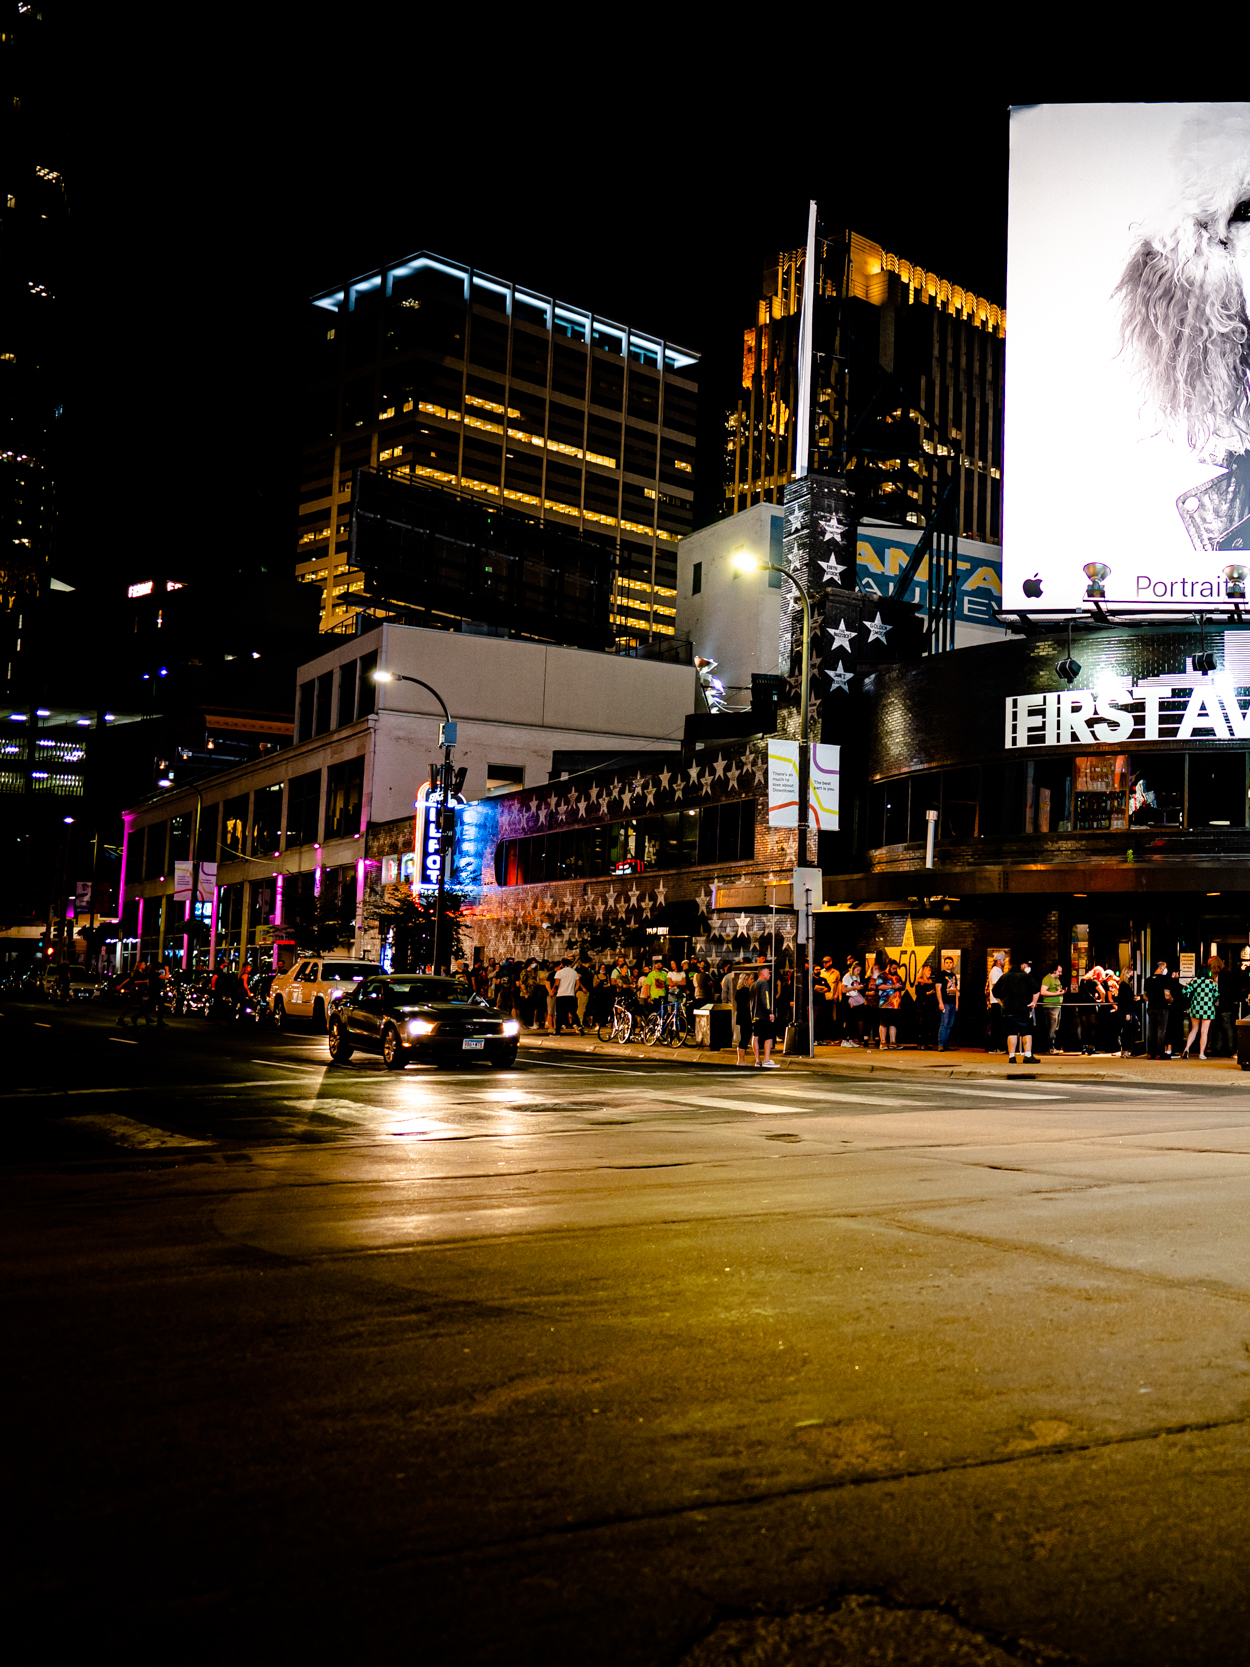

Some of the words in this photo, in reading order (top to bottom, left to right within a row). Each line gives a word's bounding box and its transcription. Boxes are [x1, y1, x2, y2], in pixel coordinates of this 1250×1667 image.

[869, 622, 888, 631] GOLDEN
[872, 629, 885, 638] SMOG
[1017, 687, 1172, 745] FIRST
[899, 950, 917, 988] 50
